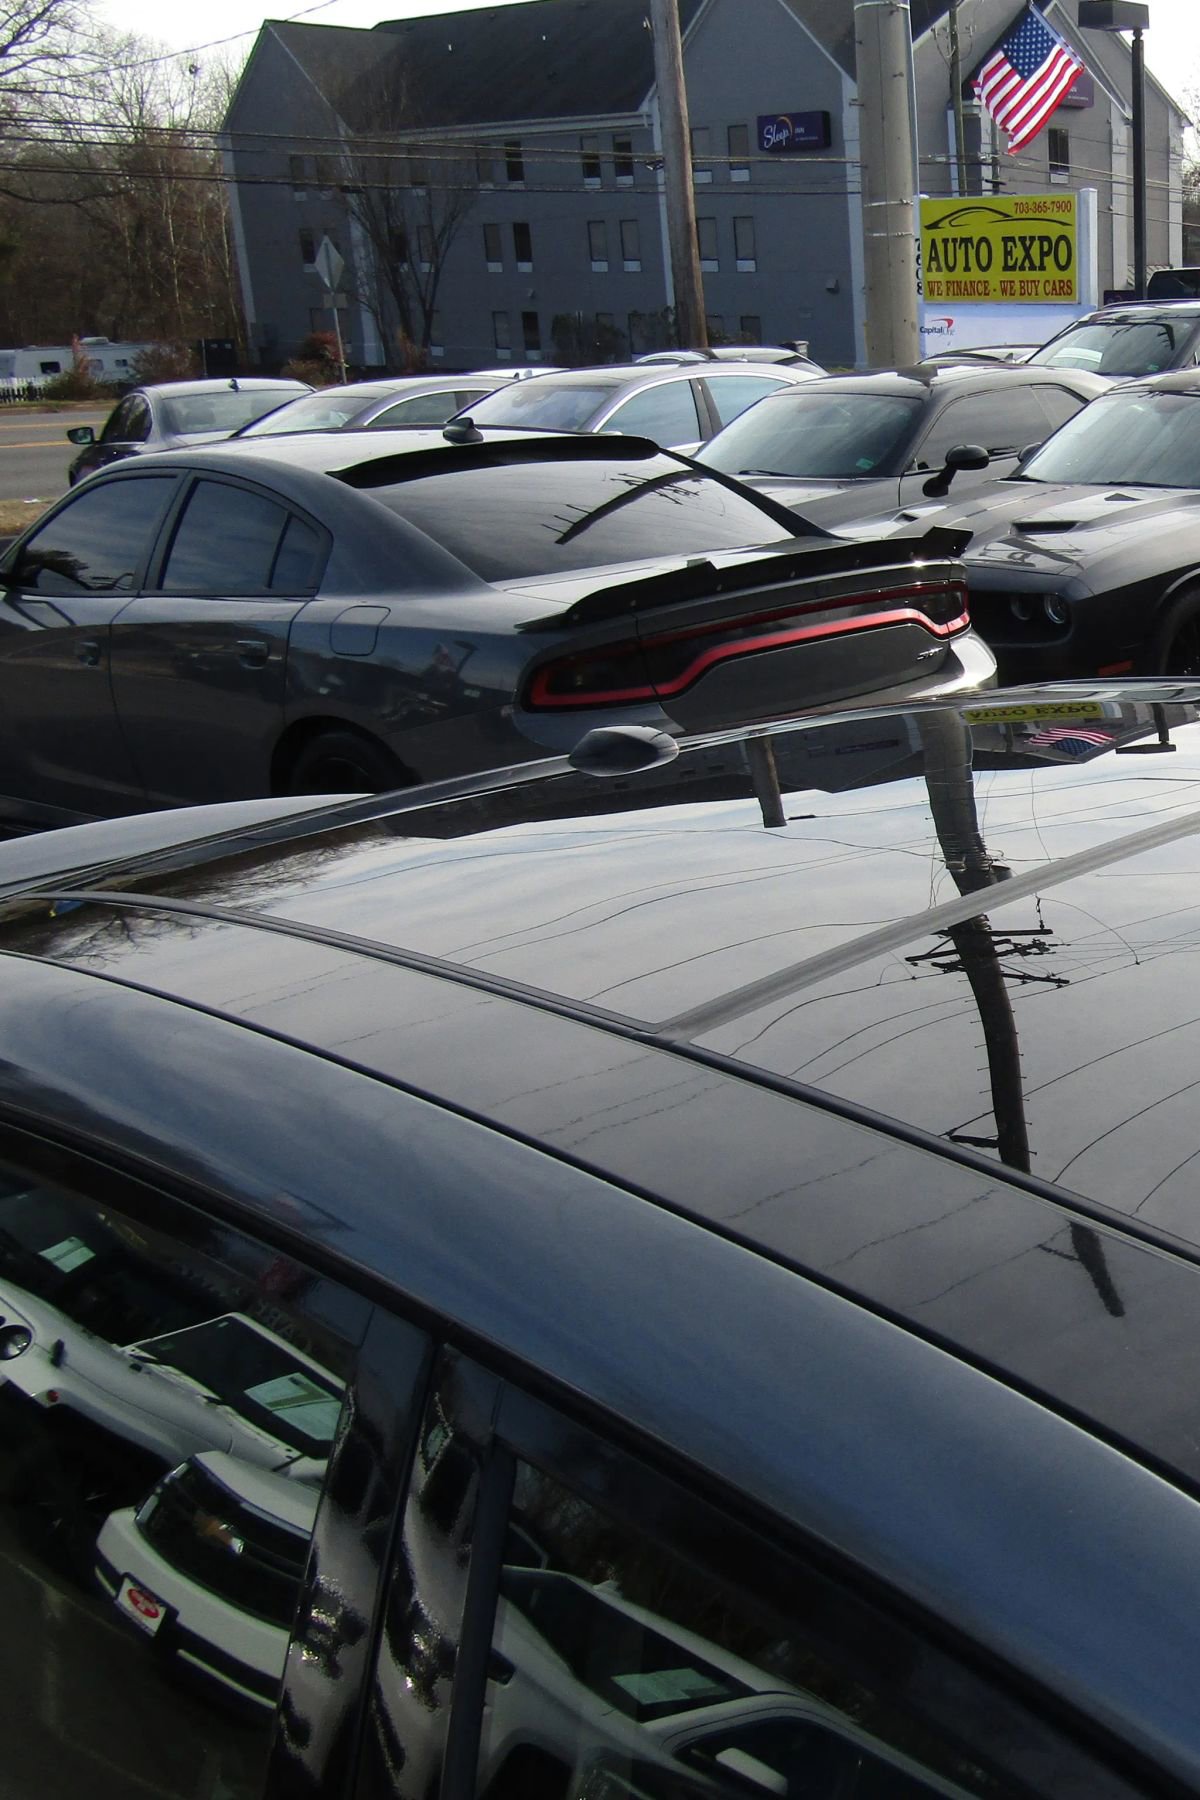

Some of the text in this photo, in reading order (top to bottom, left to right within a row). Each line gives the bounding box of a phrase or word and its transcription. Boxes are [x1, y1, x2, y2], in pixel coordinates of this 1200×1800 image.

[763, 124, 789, 149] Sleep
[1014, 200, 1072, 214] 703-365-7900
[926, 234, 1073, 273] AUTO EXPO
[927, 280, 943, 296] WE
[946, 280, 990, 296] FINANCE
[1000, 279, 1016, 296] WE
[1019, 279, 1041, 296] BUY
[1043, 279, 1073, 296] CARS
